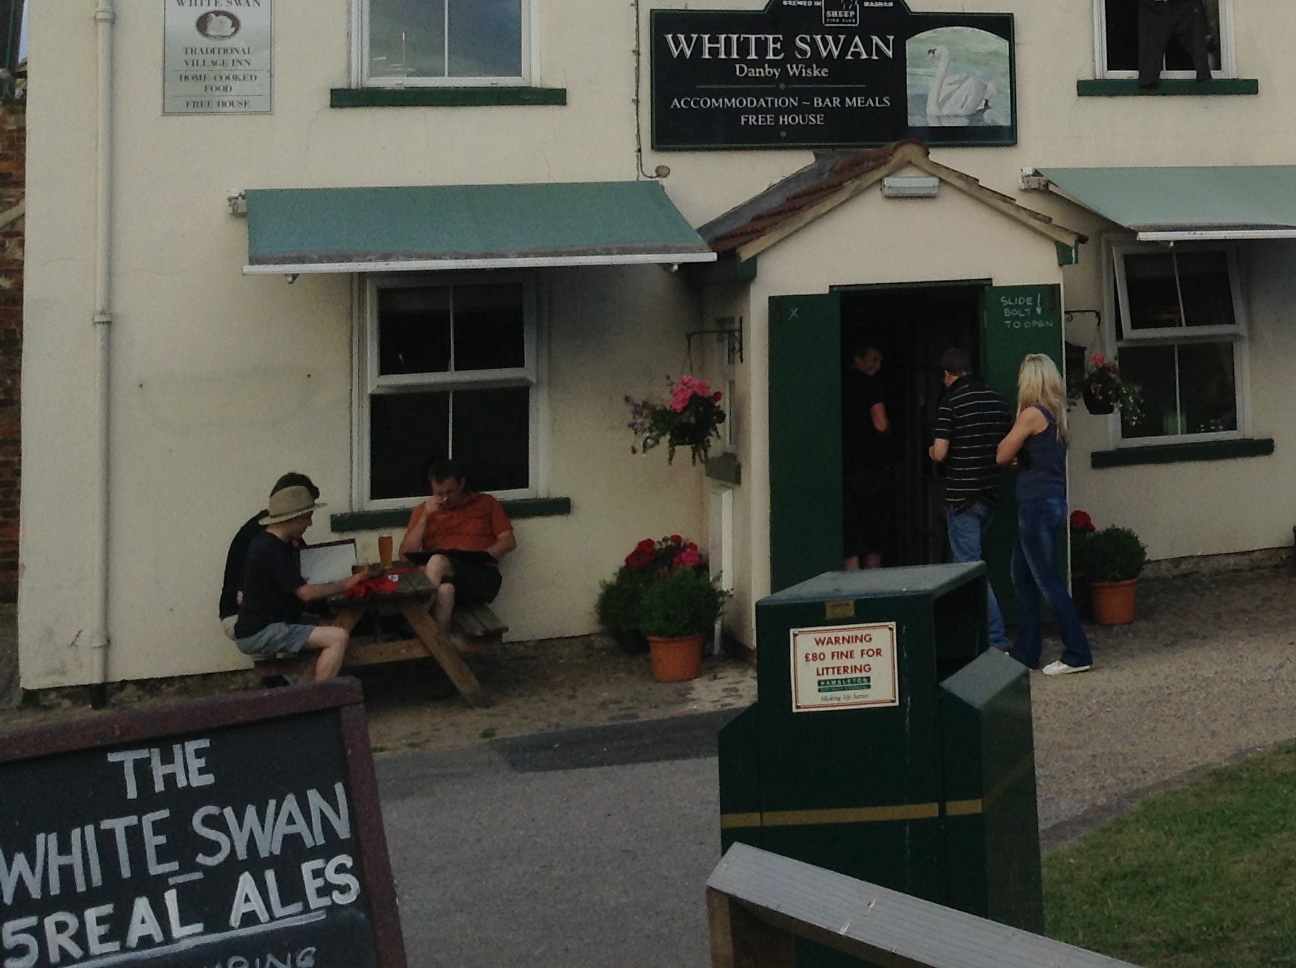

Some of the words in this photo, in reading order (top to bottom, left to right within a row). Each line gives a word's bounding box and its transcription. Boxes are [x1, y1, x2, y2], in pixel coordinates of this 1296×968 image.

[183, 46, 252, 55] TRADITIONAL
[664, 33, 785, 60] WHITE
[794, 33, 895, 60] SWAN
[184, 58, 229, 67] VILLAGE
[231, 58, 252, 67] INN
[734, 63, 781, 79] Danby
[786, 63, 829, 77] Wiske
[213, 74, 258, 82] COOKED
[204, 85, 233, 93] FOOD
[185, 100, 214, 109] FREE
[217, 100, 251, 109] HOUSE
[670, 96, 799, 109] ACCOMMODATION
[813, 96, 841, 108] BAR
[845, 96, 891, 108] MEALS
[740, 114, 775, 126] FREE
[779, 113, 825, 125] HOUSE
[1000, 296, 1033, 307] SLIDE
[1003, 308, 1031, 317] BOLT
[1004, 320, 1020, 329] TO
[814, 633, 873, 647] WARNING
[804, 652, 826, 662] £80
[831, 649, 855, 661] FINE
[860, 648, 883, 658] FOR
[816, 663, 872, 677] LITTERING
[107, 738, 216, 799] THE
[0, 809, 180, 906] WHITE
[192, 782, 352, 867] SWAN
[229, 854, 361, 929] ALES
